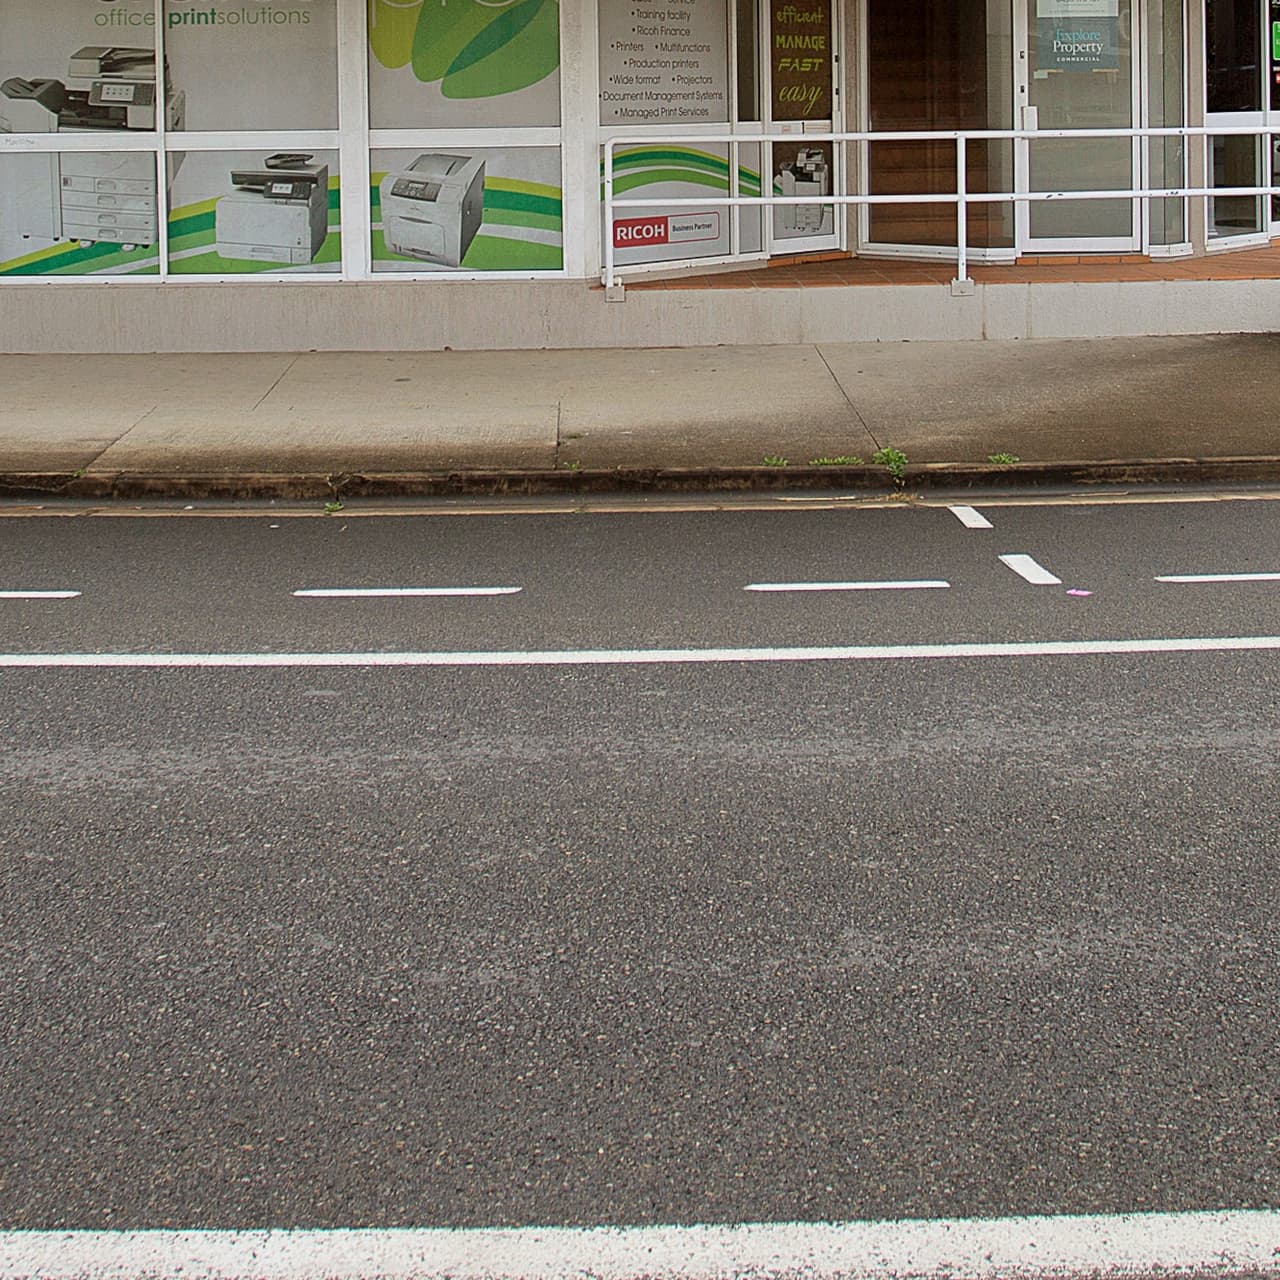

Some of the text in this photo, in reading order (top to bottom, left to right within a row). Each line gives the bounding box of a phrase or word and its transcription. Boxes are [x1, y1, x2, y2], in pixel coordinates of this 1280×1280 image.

[636, 9, 691, 22] Training facility
[776, 5, 824, 23] efficient
[637, 25, 690, 36] Ricoh Finance
[1056, 28, 1101, 45] Explore
[616, 41, 644, 52] Printers
[776, 35, 825, 51] MANAGE
[1053, 40, 1104, 56] Property
[628, 58, 699, 70] Production printers
[778, 58, 823, 71] FAST
[613, 74, 661, 85] Wide format
[676, 74, 713, 86] Projectors
[603, 91, 723, 103] Document Management Systems
[779, 82, 823, 116] easy
[620, 107, 709, 119] Managed Print Services
[616, 224, 665, 240] RICOH
